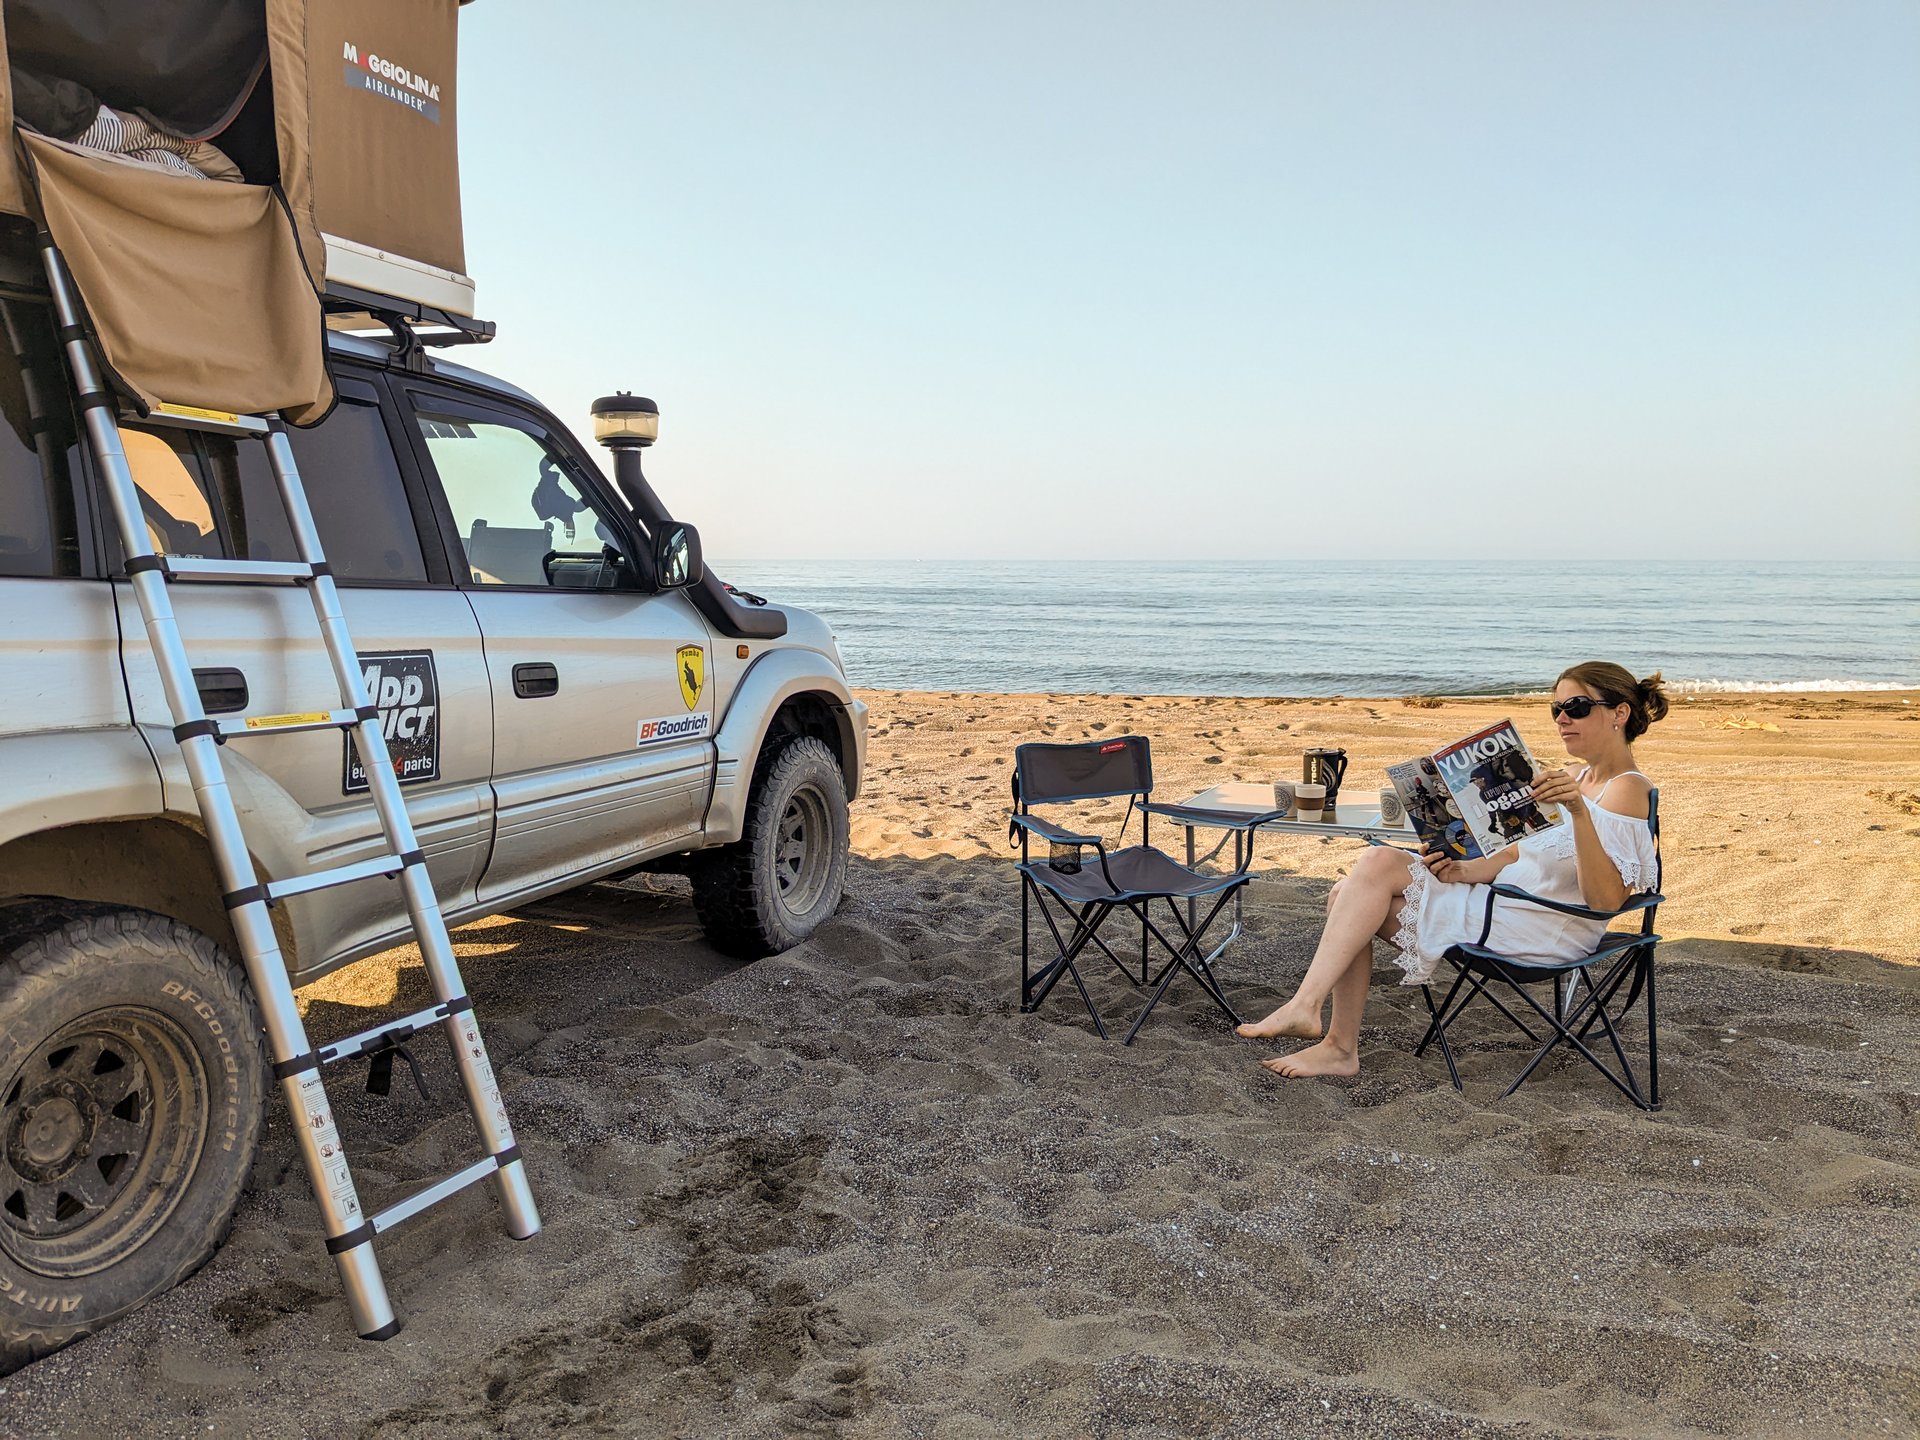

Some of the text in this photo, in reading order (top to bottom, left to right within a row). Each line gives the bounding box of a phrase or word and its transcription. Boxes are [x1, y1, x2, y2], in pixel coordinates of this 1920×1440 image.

[640, 714, 708, 740] BFGoodrich
[1438, 728, 1518, 776] YUKON
[161, 980, 241, 1152] BFGoodrich
